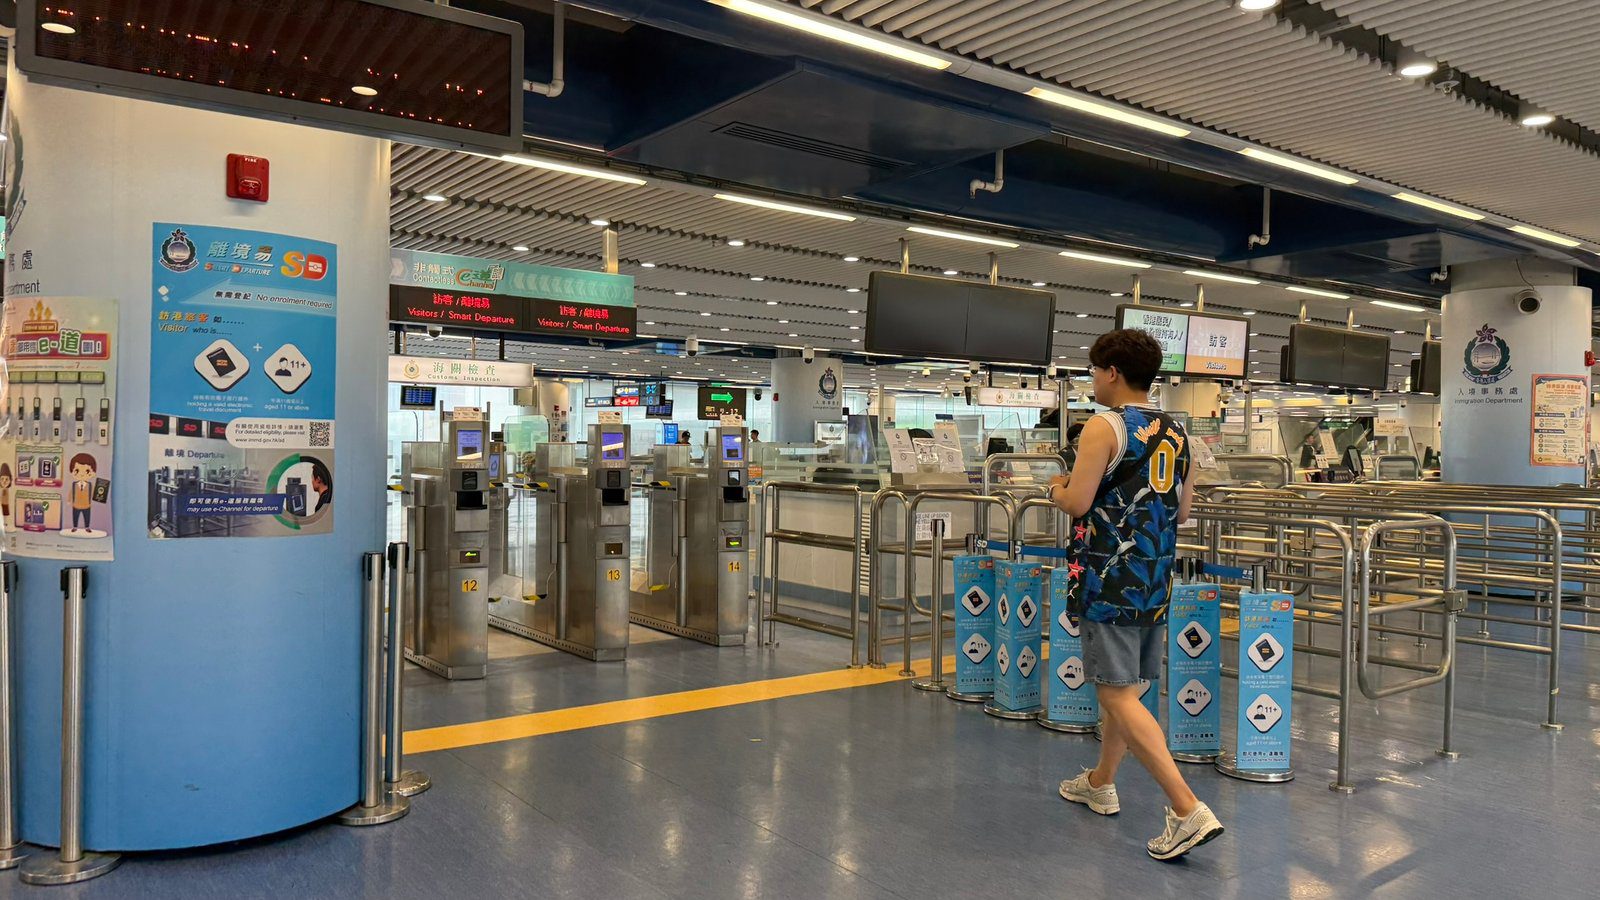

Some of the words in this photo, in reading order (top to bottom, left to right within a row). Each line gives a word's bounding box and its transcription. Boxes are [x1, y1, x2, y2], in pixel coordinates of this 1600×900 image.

[206, 240, 274, 262] 離境易
[280, 250, 328, 281] SD
[413, 273, 455, 286] Contactless
[215, 290, 252, 300] 無需登記
[433, 293, 453, 306] 訪客
[269, 295, 306, 306] enrolment
[308, 300, 332, 309] required
[408, 308, 438, 318] Visitors
[448, 311, 472, 322] Smart
[474, 312, 515, 325] Departure
[560, 305, 578, 317] 訪客
[158, 323, 188, 333] Visitor
[538, 318, 564, 328] Visitors
[572, 321, 593, 331] Smart
[595, 323, 630, 334] Departure
[290, 360, 306, 368] 11+
[433, 362, 496, 376] 海關檢查
[1458, 387, 1518, 396] 入境事務處
[165, 448, 184, 458] 離境
[187, 449, 225, 459] Departure
[1149, 439, 1176, 493] 0
[729, 562, 740, 572] 14
[608, 569, 620, 580] 13
[464, 580, 478, 592] 12
